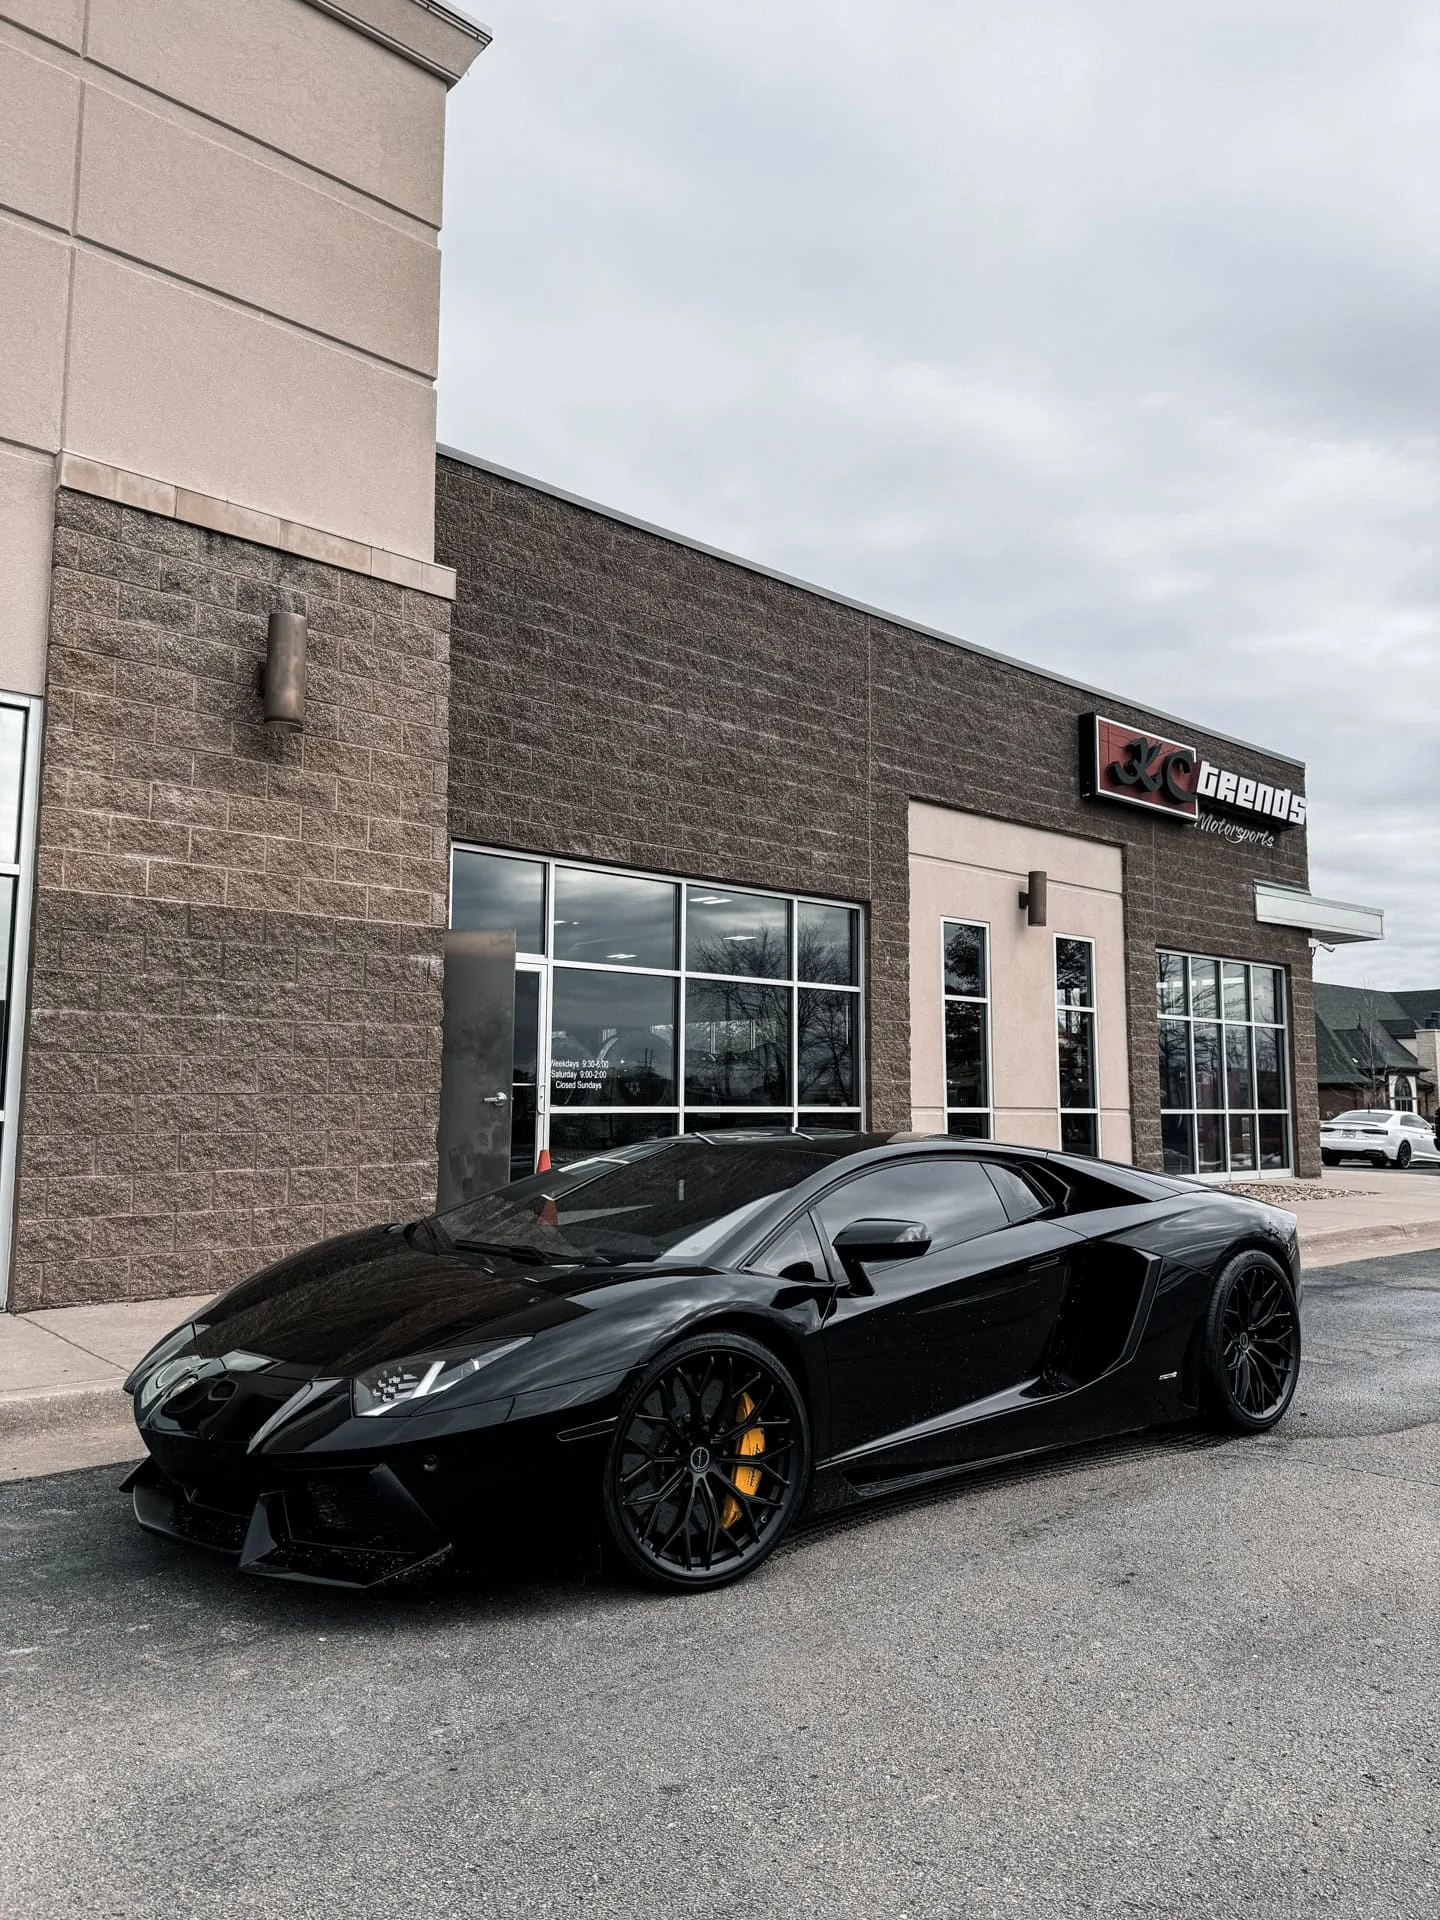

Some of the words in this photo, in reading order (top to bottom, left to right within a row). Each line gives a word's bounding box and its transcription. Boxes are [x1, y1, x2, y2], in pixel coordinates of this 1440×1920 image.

[1194, 812, 1274, 847] Motorsports
[551, 1059, 580, 1070] Weekdays
[551, 1069, 577, 1080] Saturday
[579, 1070, 607, 1079] 9:00-2:00
[555, 1080, 576, 1089] Closed
[577, 1080, 602, 1091] Sundays
